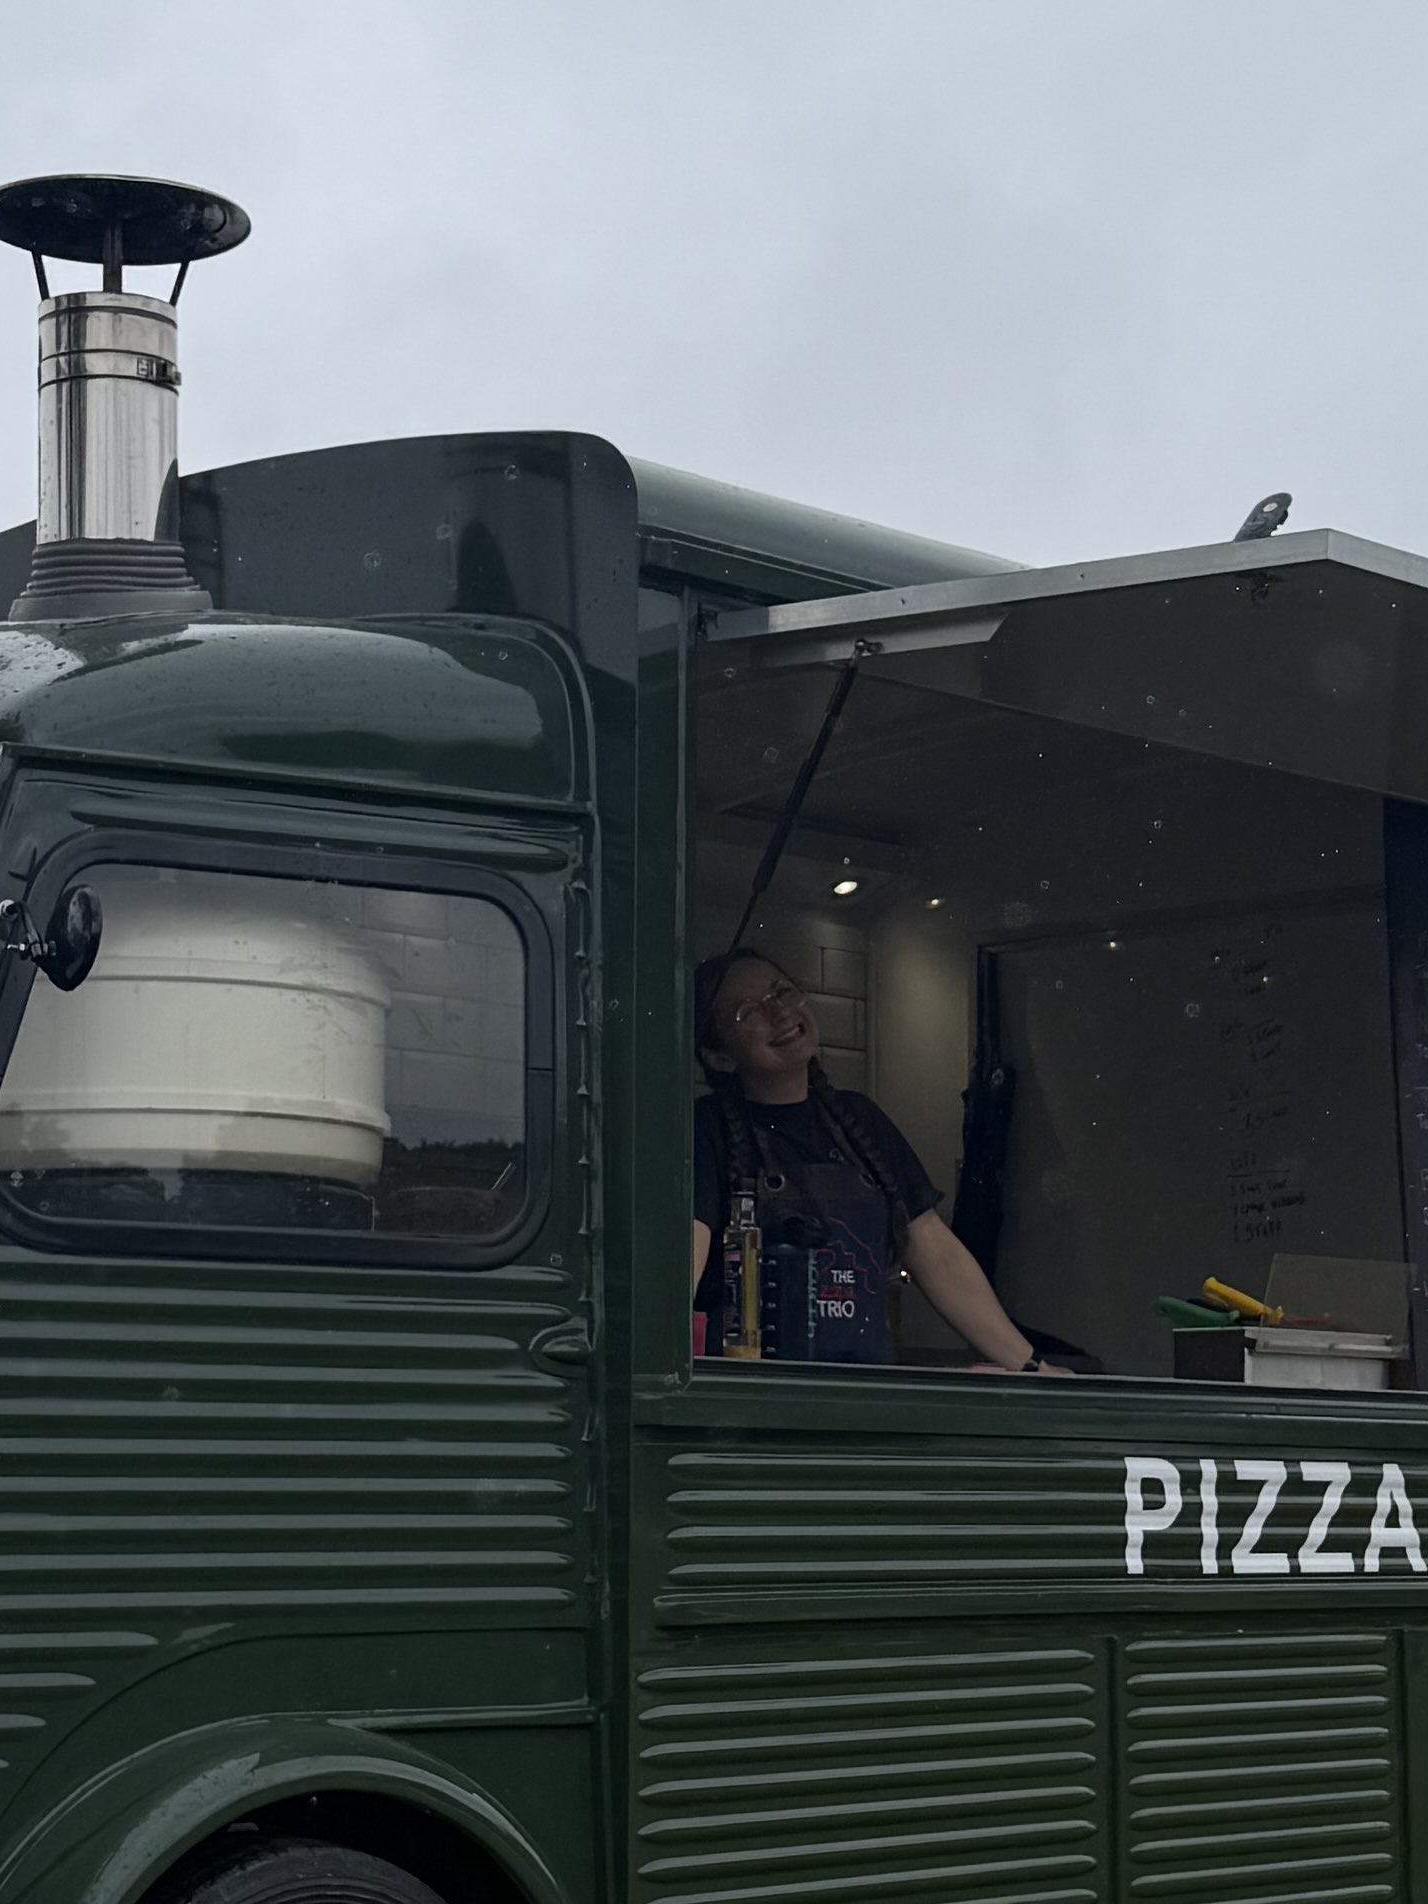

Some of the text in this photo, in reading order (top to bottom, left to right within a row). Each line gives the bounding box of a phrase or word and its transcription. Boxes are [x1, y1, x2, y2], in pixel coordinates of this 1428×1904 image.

[831, 1270, 855, 1284] THE
[816, 1300, 855, 1318] TRIO
[1124, 1457, 1428, 1574] PIZZA
